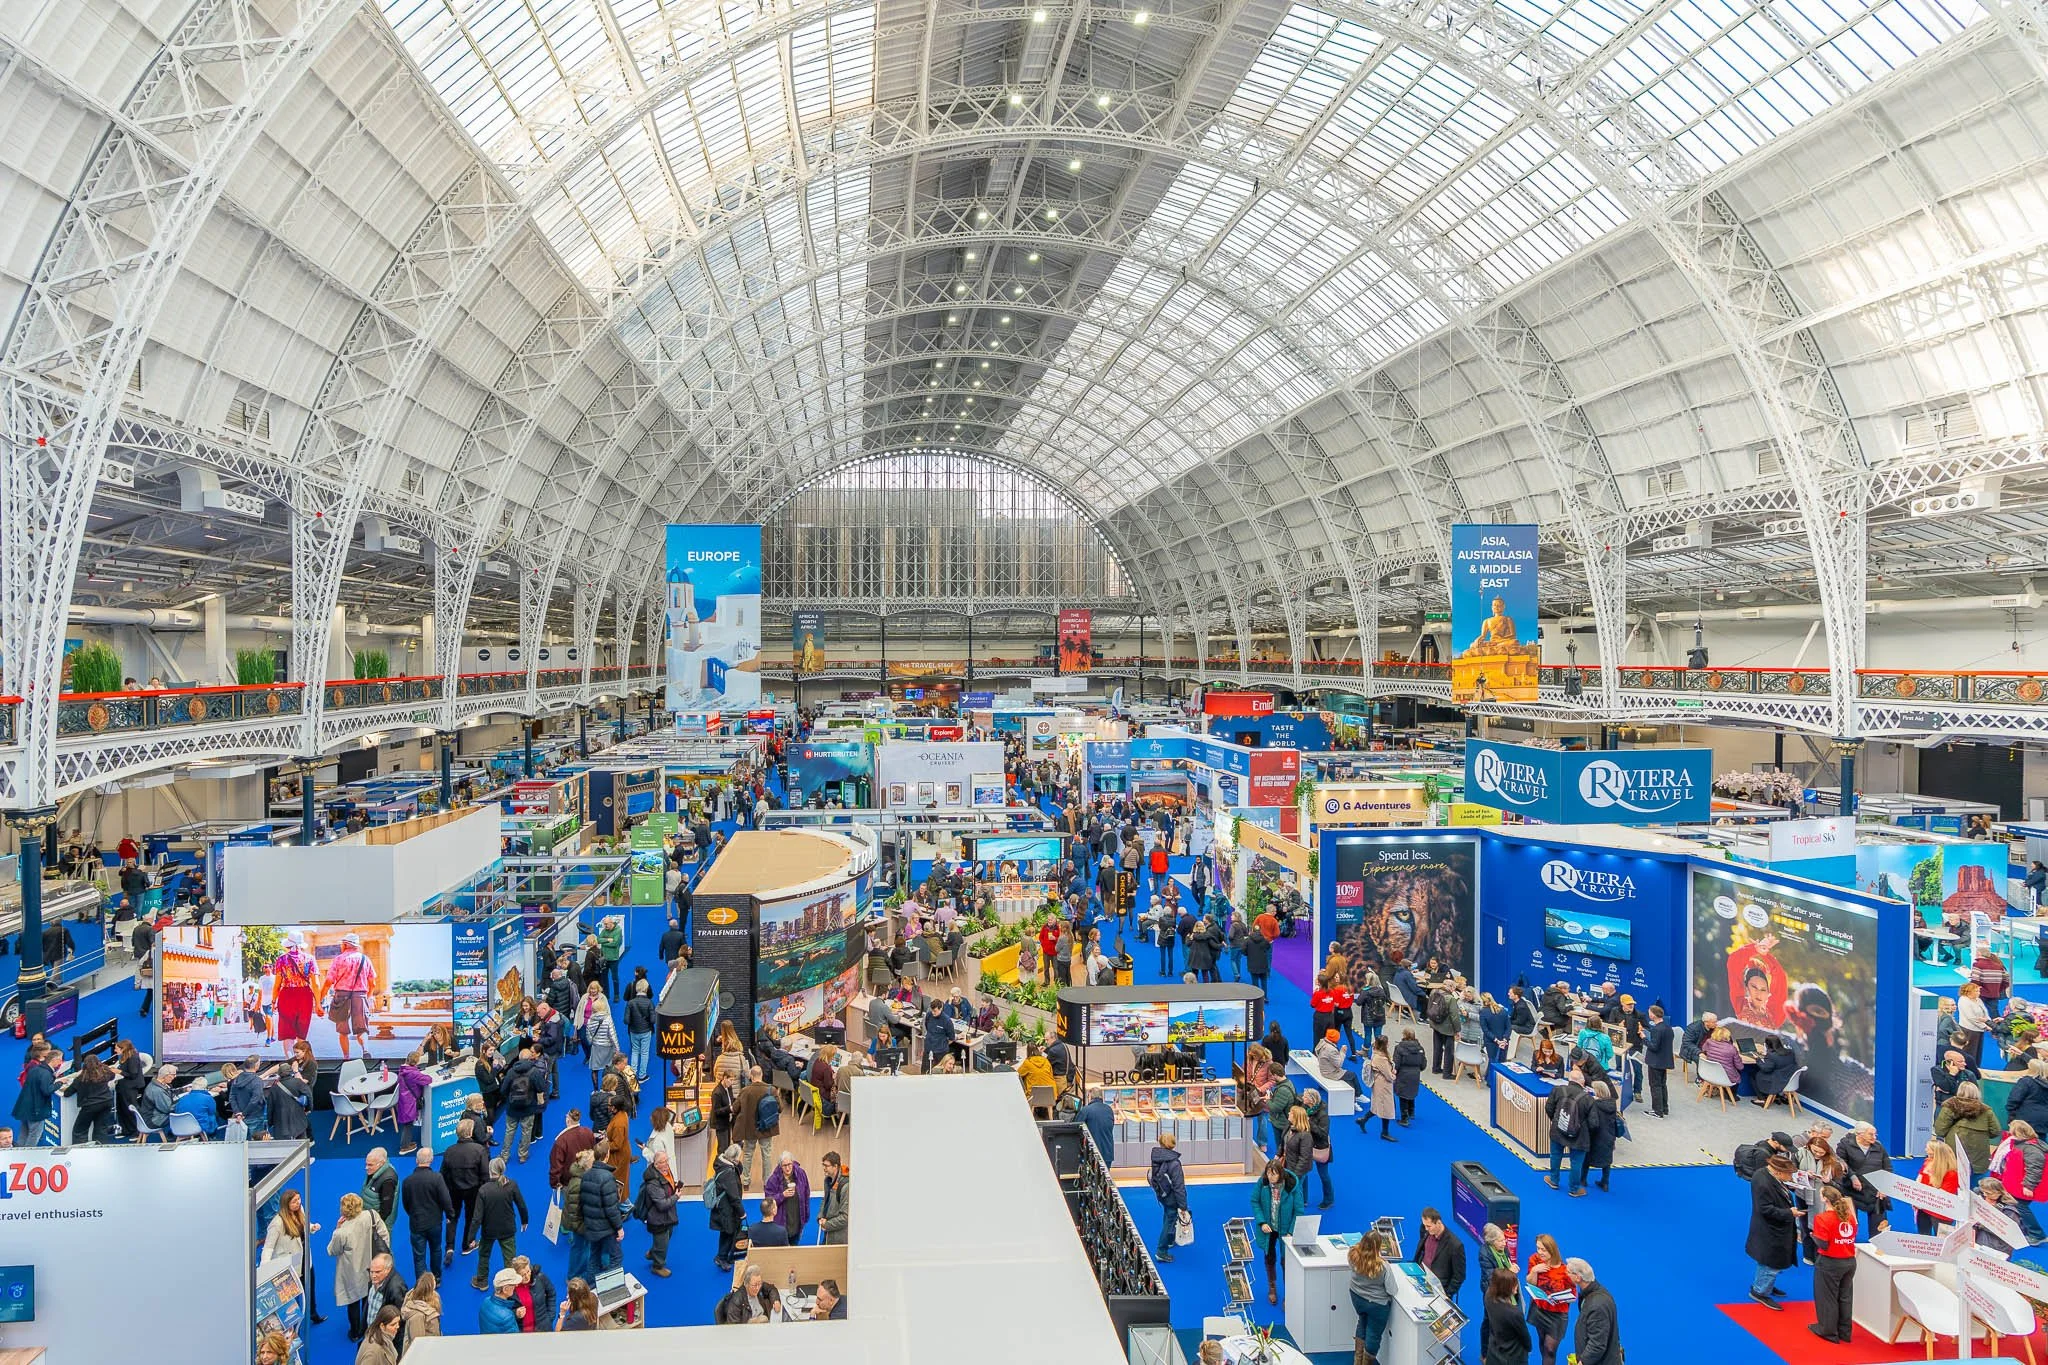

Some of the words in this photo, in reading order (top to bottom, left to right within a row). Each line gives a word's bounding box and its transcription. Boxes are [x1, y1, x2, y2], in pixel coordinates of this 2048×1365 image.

[1481, 536, 1510, 547] ASIA,
[687, 551, 741, 562] EUROPE
[1457, 550, 1534, 560] AUSTRALASIA
[1469, 564, 1477, 574] &
[1479, 564, 1522, 574] MIDDLE
[1481, 578, 1510, 588] EAST
[933, 729, 955, 737] Explore!
[919, 752, 964, 761] OCEANIA
[1480, 753, 1549, 788] RIVIERA
[1503, 780, 1549, 799] TRAVEL
[1586, 766, 1695, 799] RIVIERA
[1628, 788, 1694, 801] TRAVEL
[1343, 801, 1351, 811] G
[1353, 801, 1412, 811] Adventures
[1791, 833, 1822, 846] Tropical
[1822, 832, 1836, 845] Sky
[1378, 849, 1409, 863] Spend
[1411, 849, 1431, 860] less.
[1362, 861, 1418, 877] Experience
[1547, 863, 1637, 890] RIVIERA
[1580, 883, 1637, 899] TRAVEL
[1779, 902, 1792, 912] Year
[1792, 905, 1808, 915] after
[697, 929, 749, 937] TRAILFINDERS
[1825, 926, 1854, 941] Trustpilot
[661, 1030, 695, 1047] WIN
[667, 1045, 694, 1055] HOLIDAY
[1103, 1066, 1217, 1085] BROCHURES
[1896, 1181, 1912, 1190] Spot
[1912, 1186, 1936, 1198] wildlife
[1916, 1196, 1944, 1210] Amazon
[1927, 1194, 1955, 1209] through
[34, 1208, 104, 1220] enthusiasts
[1968, 1259, 1983, 1268] Zen
[1984, 1264, 2017, 1281] Buddhist
[2018, 1278, 2040, 1289] monk
[1976, 1256, 2009, 1272] Meditate
[2009, 1270, 2026, 1279] with
[1997, 1275, 2020, 1287] Kyoto
